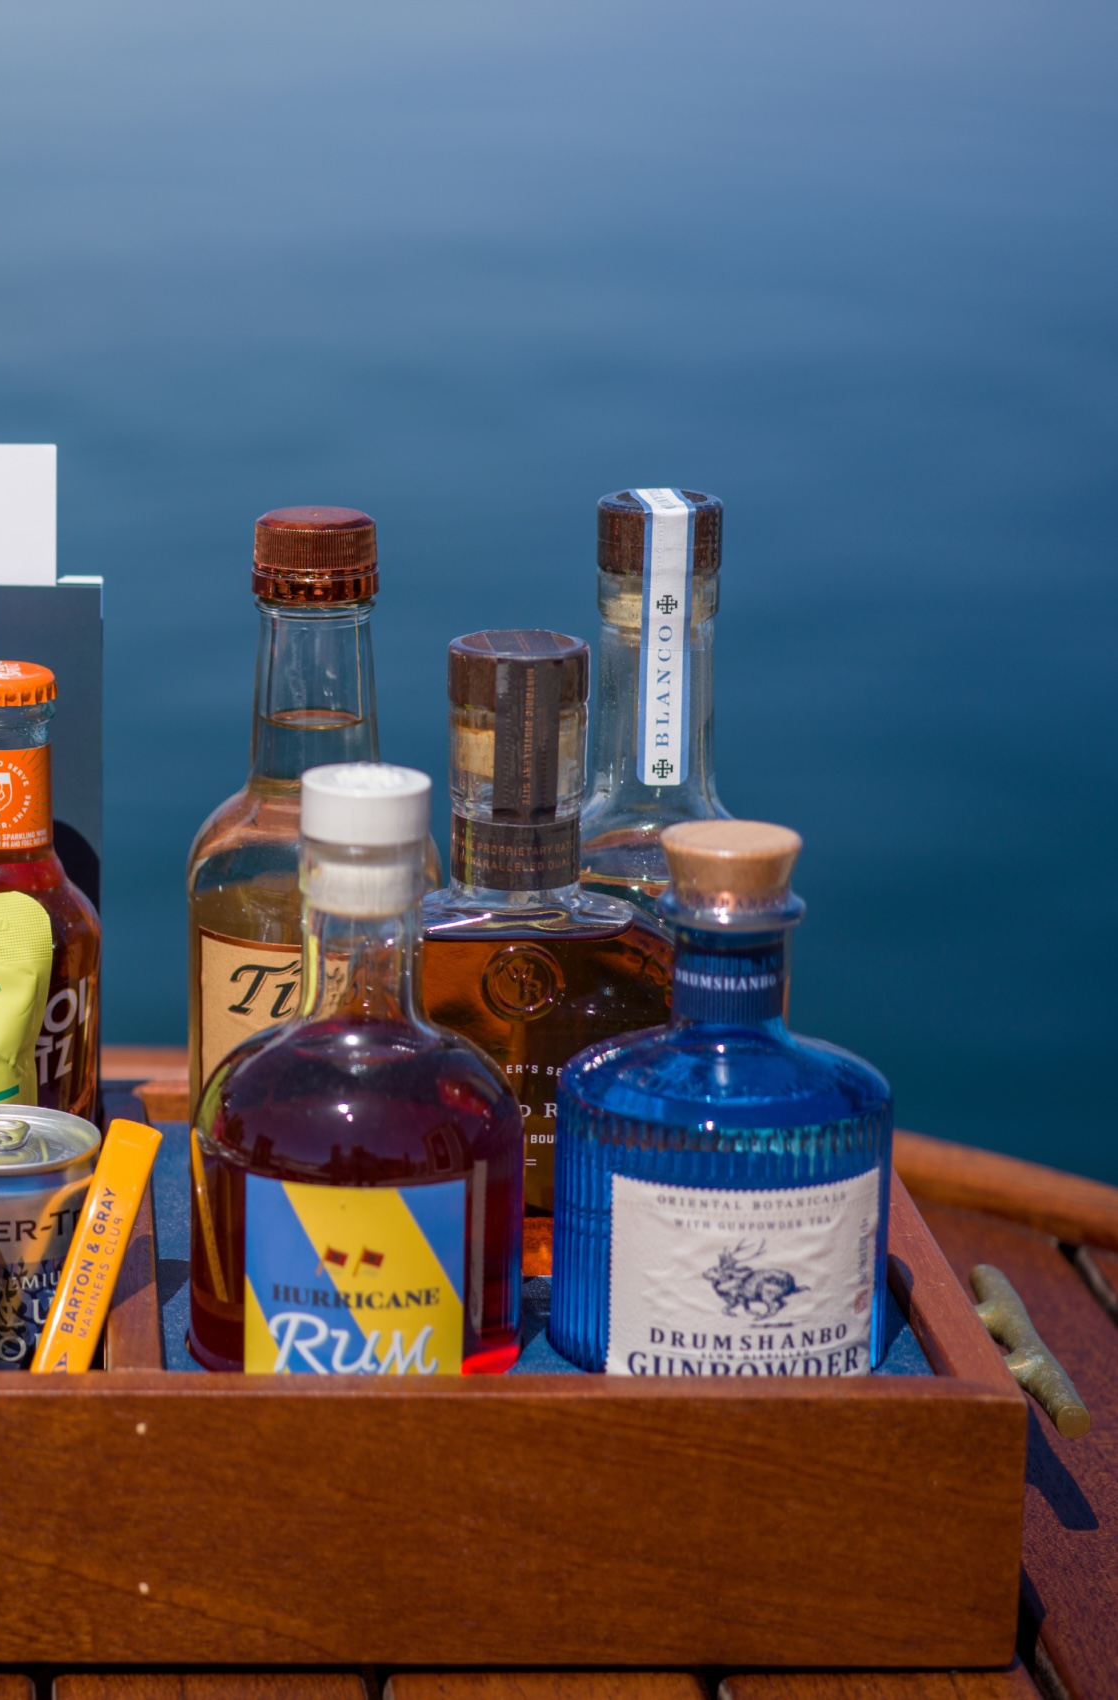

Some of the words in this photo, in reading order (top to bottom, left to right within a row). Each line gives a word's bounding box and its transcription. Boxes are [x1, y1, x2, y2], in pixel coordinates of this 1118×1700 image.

[655, 623, 673, 748] BLANCO
[7, 763, 30, 787] SERVE
[12, 794, 32, 823] SHARE
[92, 1187, 117, 1236] GRAY
[656, 1194, 742, 1211] ORIENTAL
[752, 1191, 847, 1211] BOTANICALS
[674, 1218, 711, 1230] WITH
[718, 1218, 802, 1231] GUNPOWDER
[809, 1215, 832, 1226] TEA
[86, 1242, 100, 1255] &
[60, 1259, 95, 1335] BARTON
[77, 1262, 111, 1339] MARINERS
[272, 1283, 440, 1310] HURRICANE
[650, 1323, 848, 1351] DRUMSHANBO
